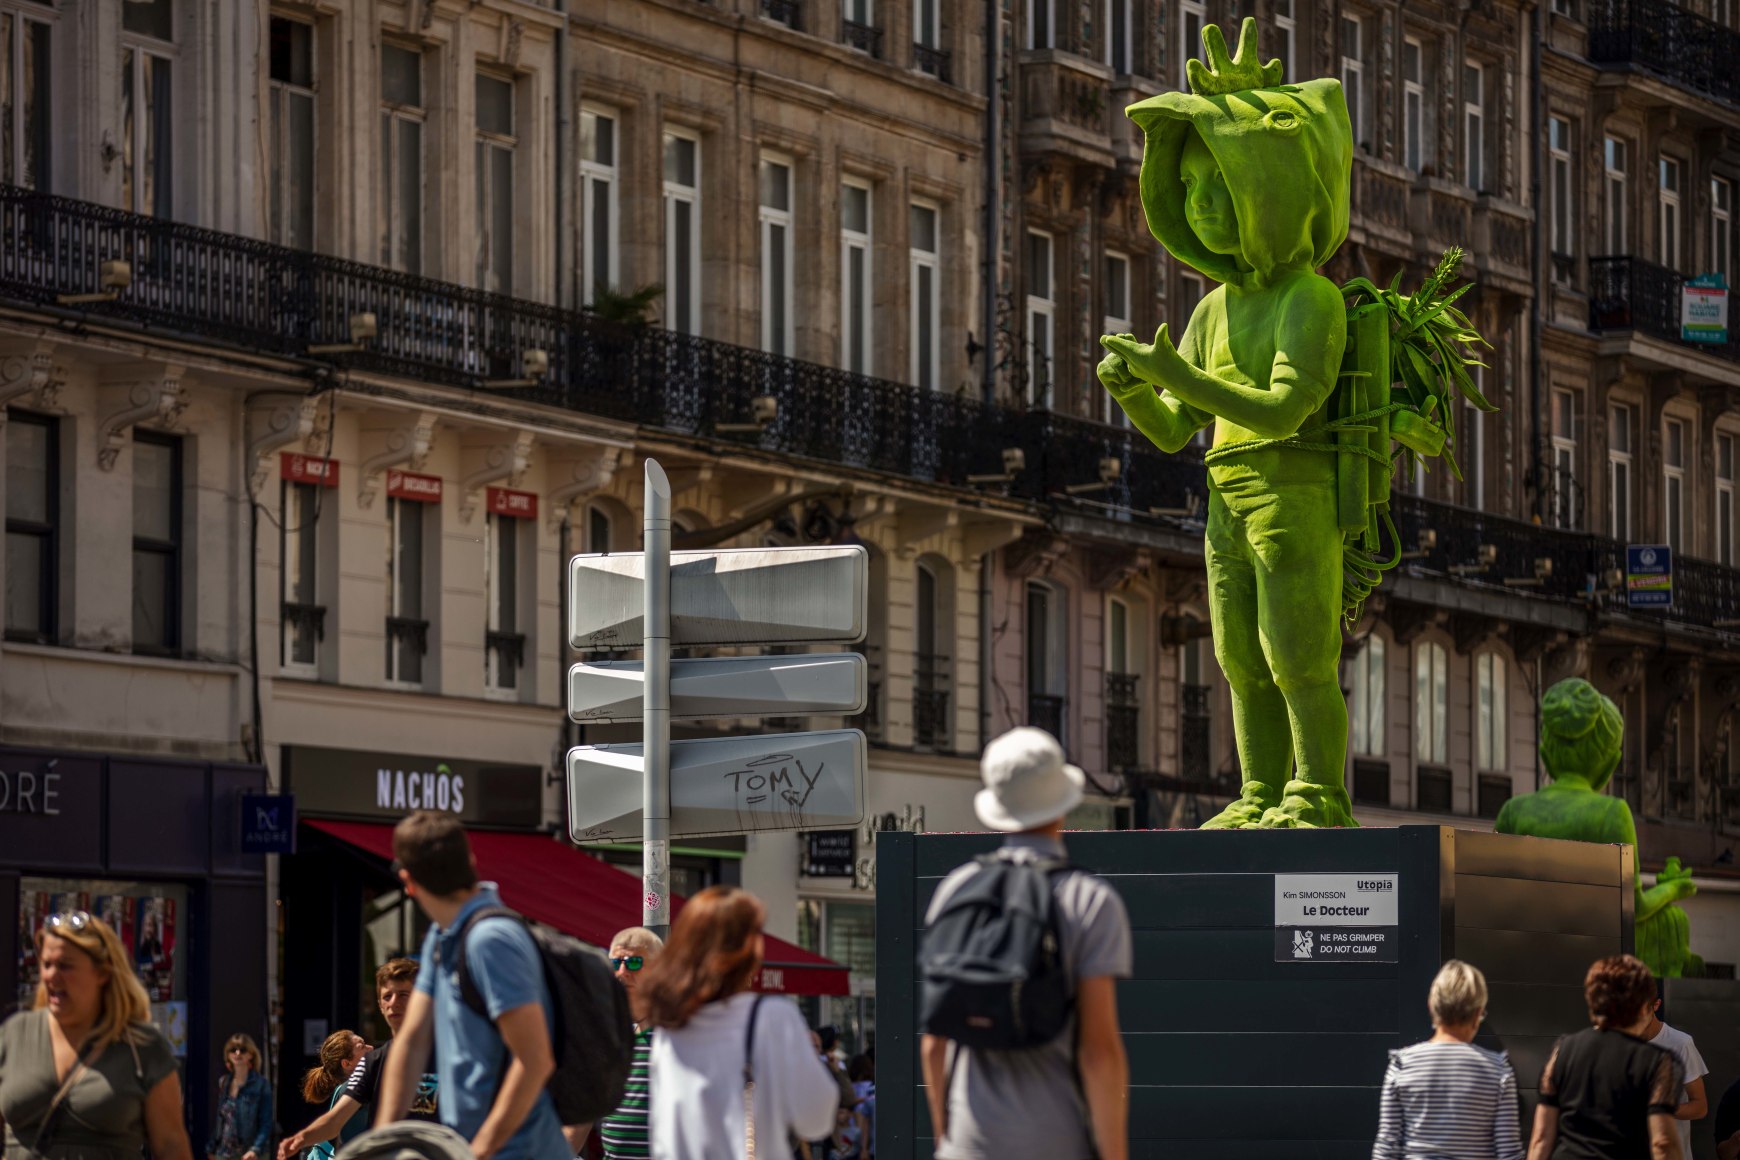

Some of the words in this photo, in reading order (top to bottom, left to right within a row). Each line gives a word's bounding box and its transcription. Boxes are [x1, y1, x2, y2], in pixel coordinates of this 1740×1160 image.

[723, 759, 825, 808] TOMY
[1357, 879, 1393, 893] Utopia
[1283, 891, 1298, 899] Kim
[1298, 891, 1346, 899] SIMONSSON
[1303, 905, 1317, 916] Le
[1320, 905, 1370, 916] Docteur
[1320, 934, 1332, 942] NE
[1332, 934, 1348, 942] PAS
[1349, 934, 1385, 942] GRIMPER
[1320, 945, 1333, 954] DO
[1334, 945, 1352, 954] NOT
[1352, 945, 1377, 954] CLIMB
